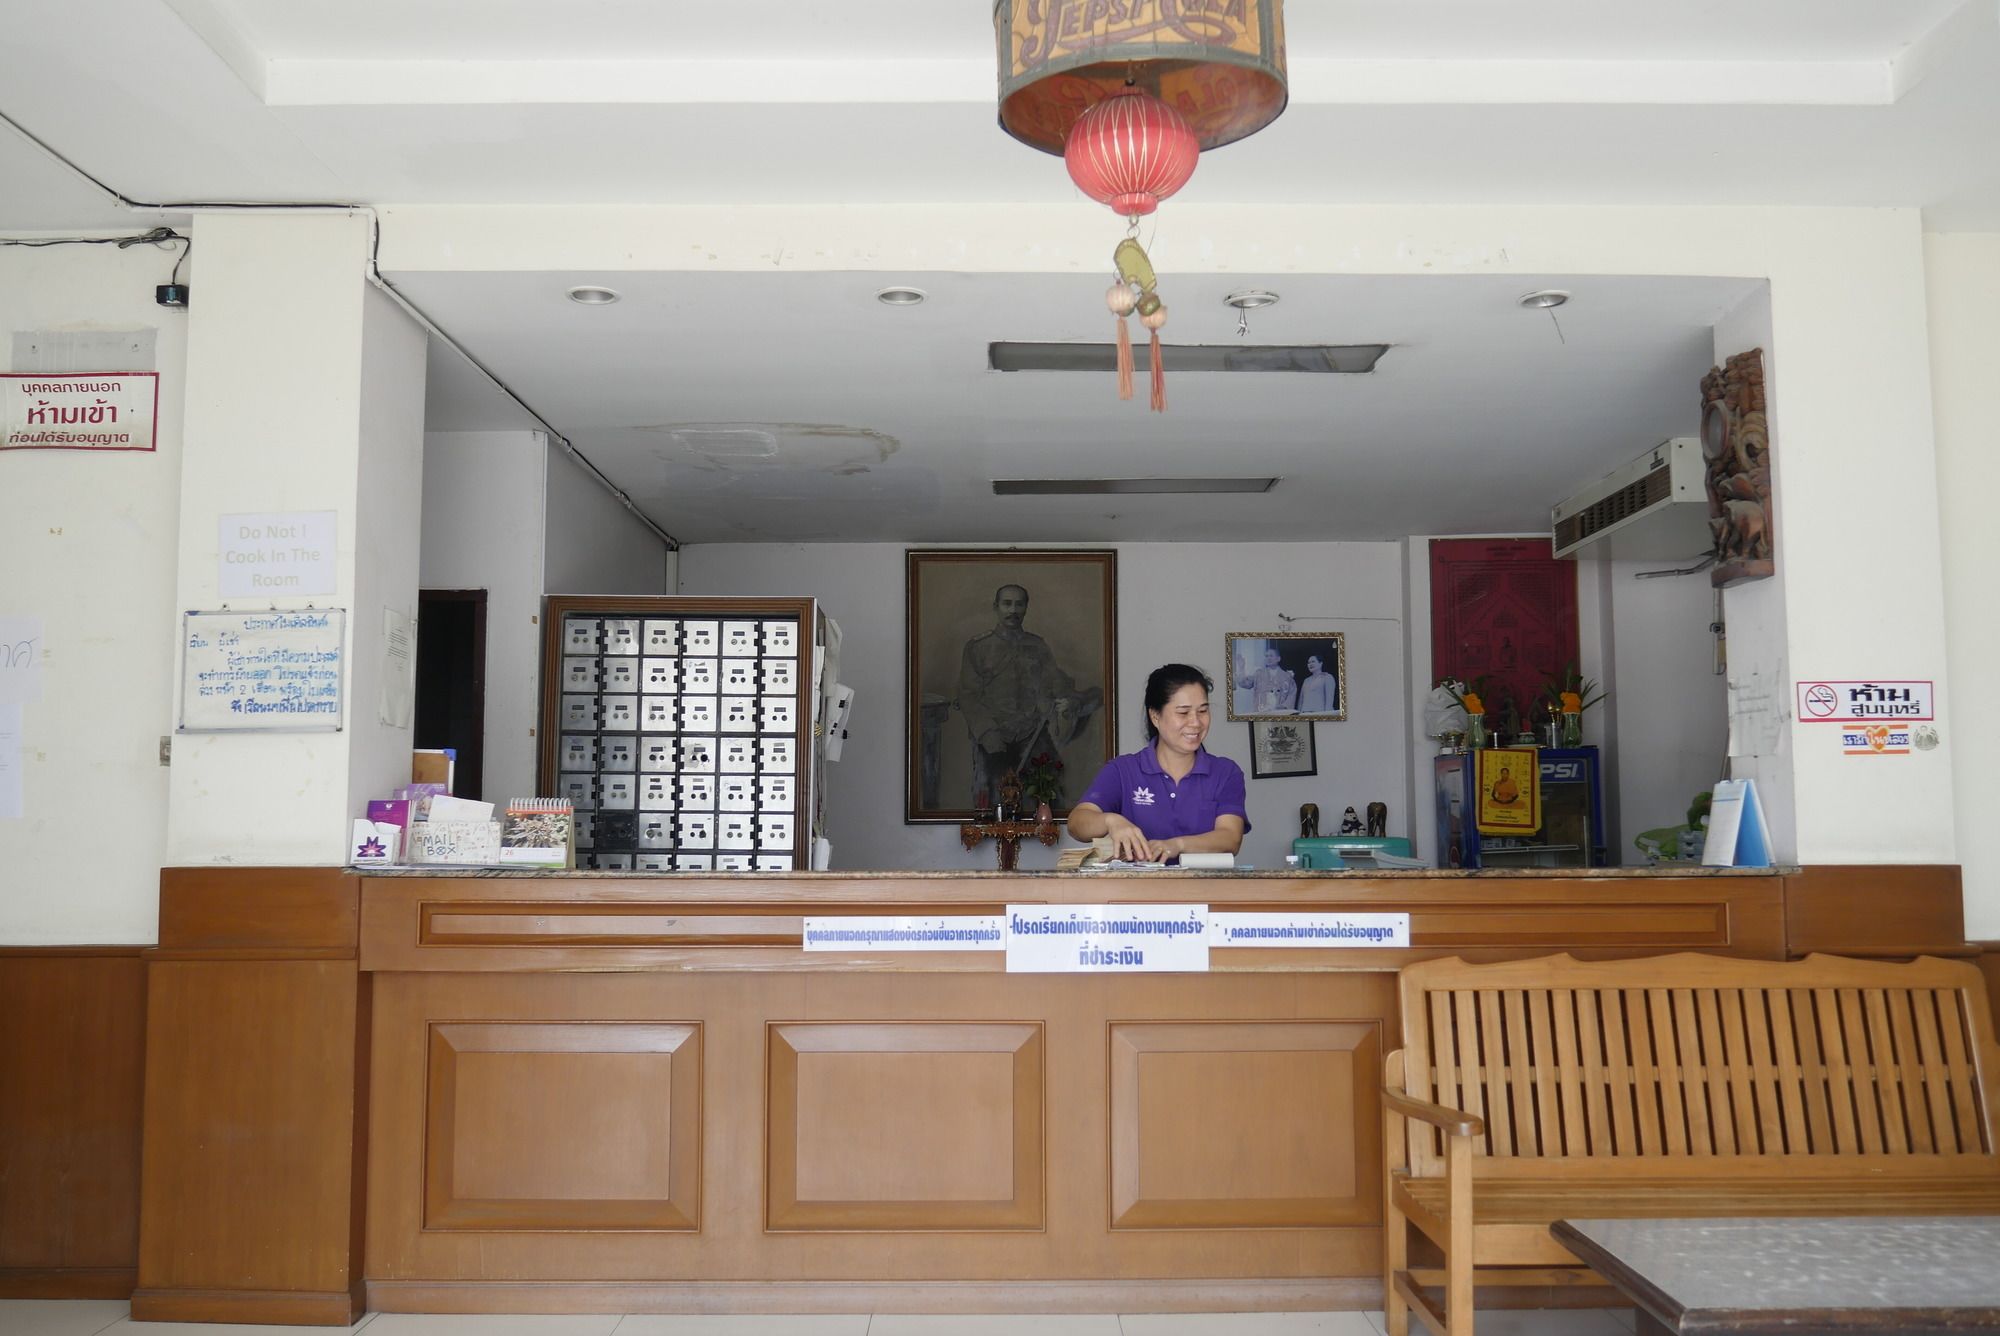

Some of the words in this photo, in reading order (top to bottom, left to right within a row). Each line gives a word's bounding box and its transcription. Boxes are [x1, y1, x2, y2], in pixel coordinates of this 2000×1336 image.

[21, 382, 121, 396] บุคคลภายนอก
[27, 398, 118, 424] ห้ามเข้า
[9, 431, 130, 446] ก่อนได้รับอนุญาต
[239, 526, 261, 539] Do
[266, 526, 297, 539] Not
[225, 549, 265, 564] Cook
[271, 549, 286, 562] In
[290, 548, 320, 561] The
[252, 574, 299, 587] Room
[1849, 684, 1910, 702] ห้าม
[1851, 700, 1920, 717] สูบบุหรี่
[1540, 763, 1578, 778] PSI
[1079, 940, 1143, 965] ที่ชำระเงิน
